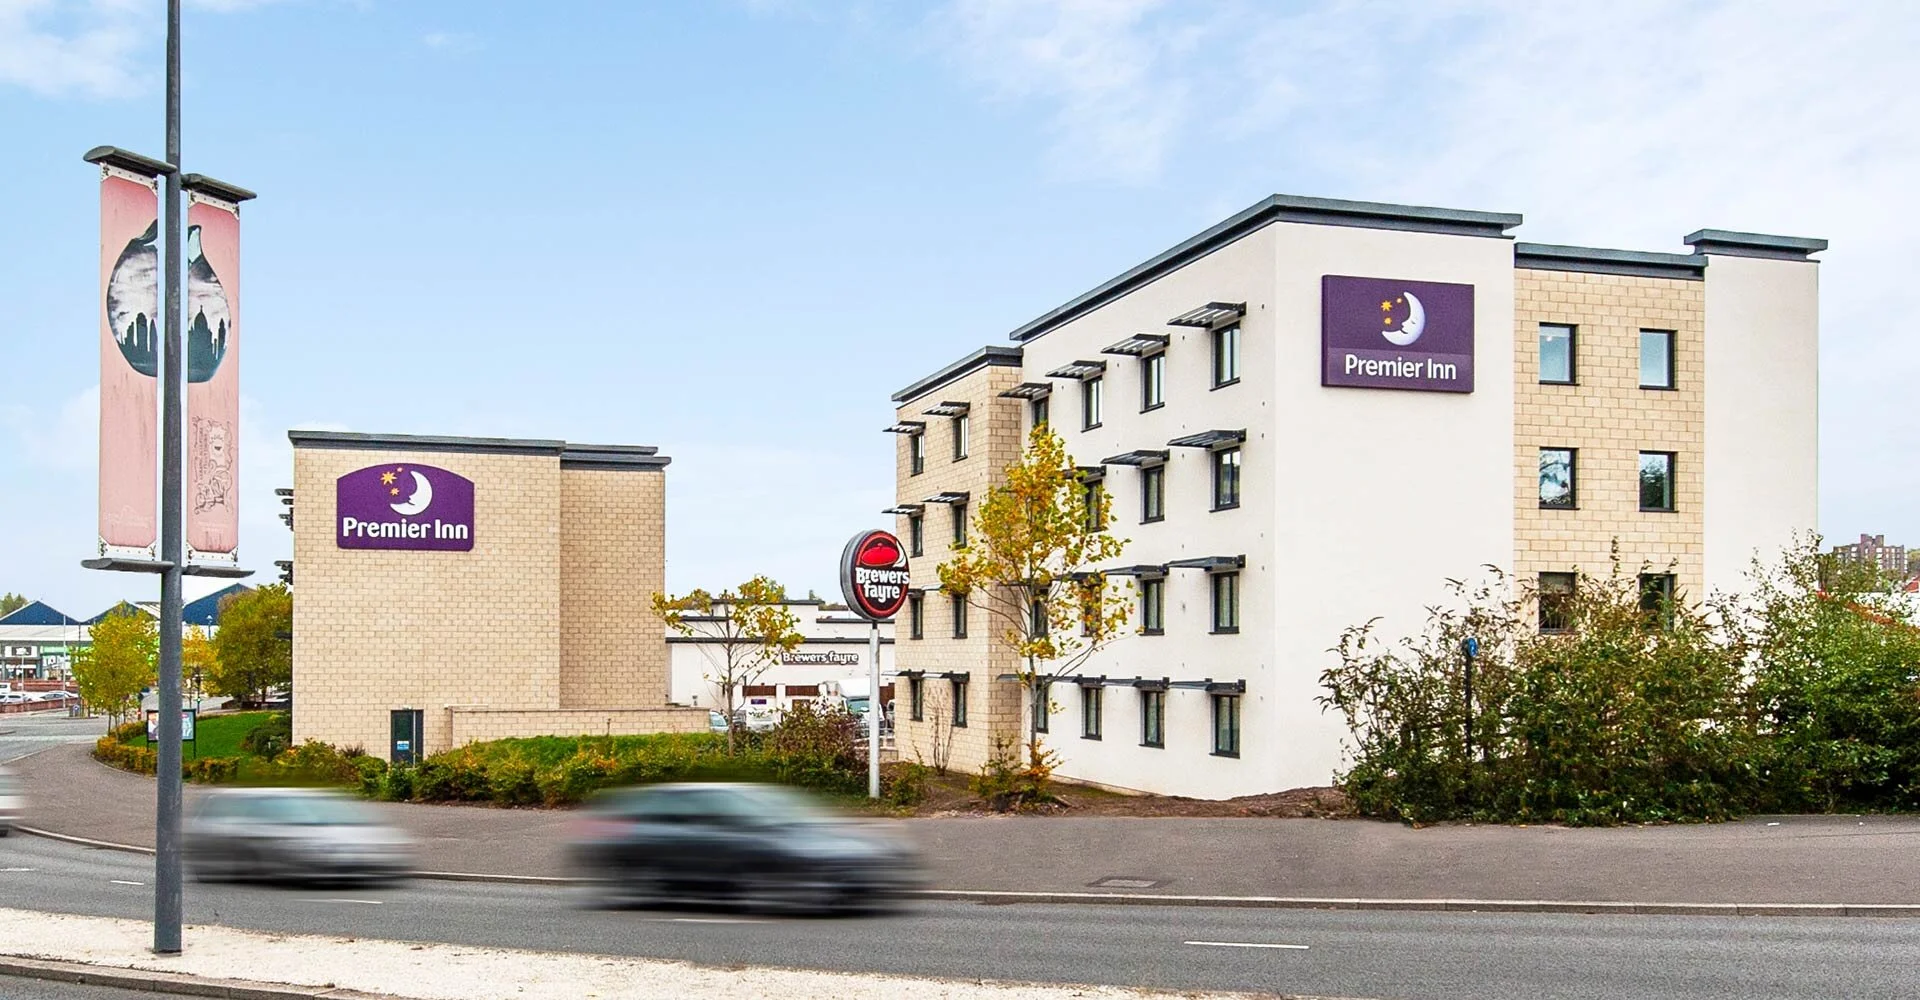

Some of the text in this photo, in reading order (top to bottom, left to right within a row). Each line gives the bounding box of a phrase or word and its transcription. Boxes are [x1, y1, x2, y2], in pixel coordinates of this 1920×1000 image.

[1345, 354, 1456, 379] Premier Inn
[342, 517, 468, 539] Premier Inn
[855, 567, 909, 584] Brewers
[863, 580, 900, 603] fayre
[782, 651, 858, 665] Brewers fayre
